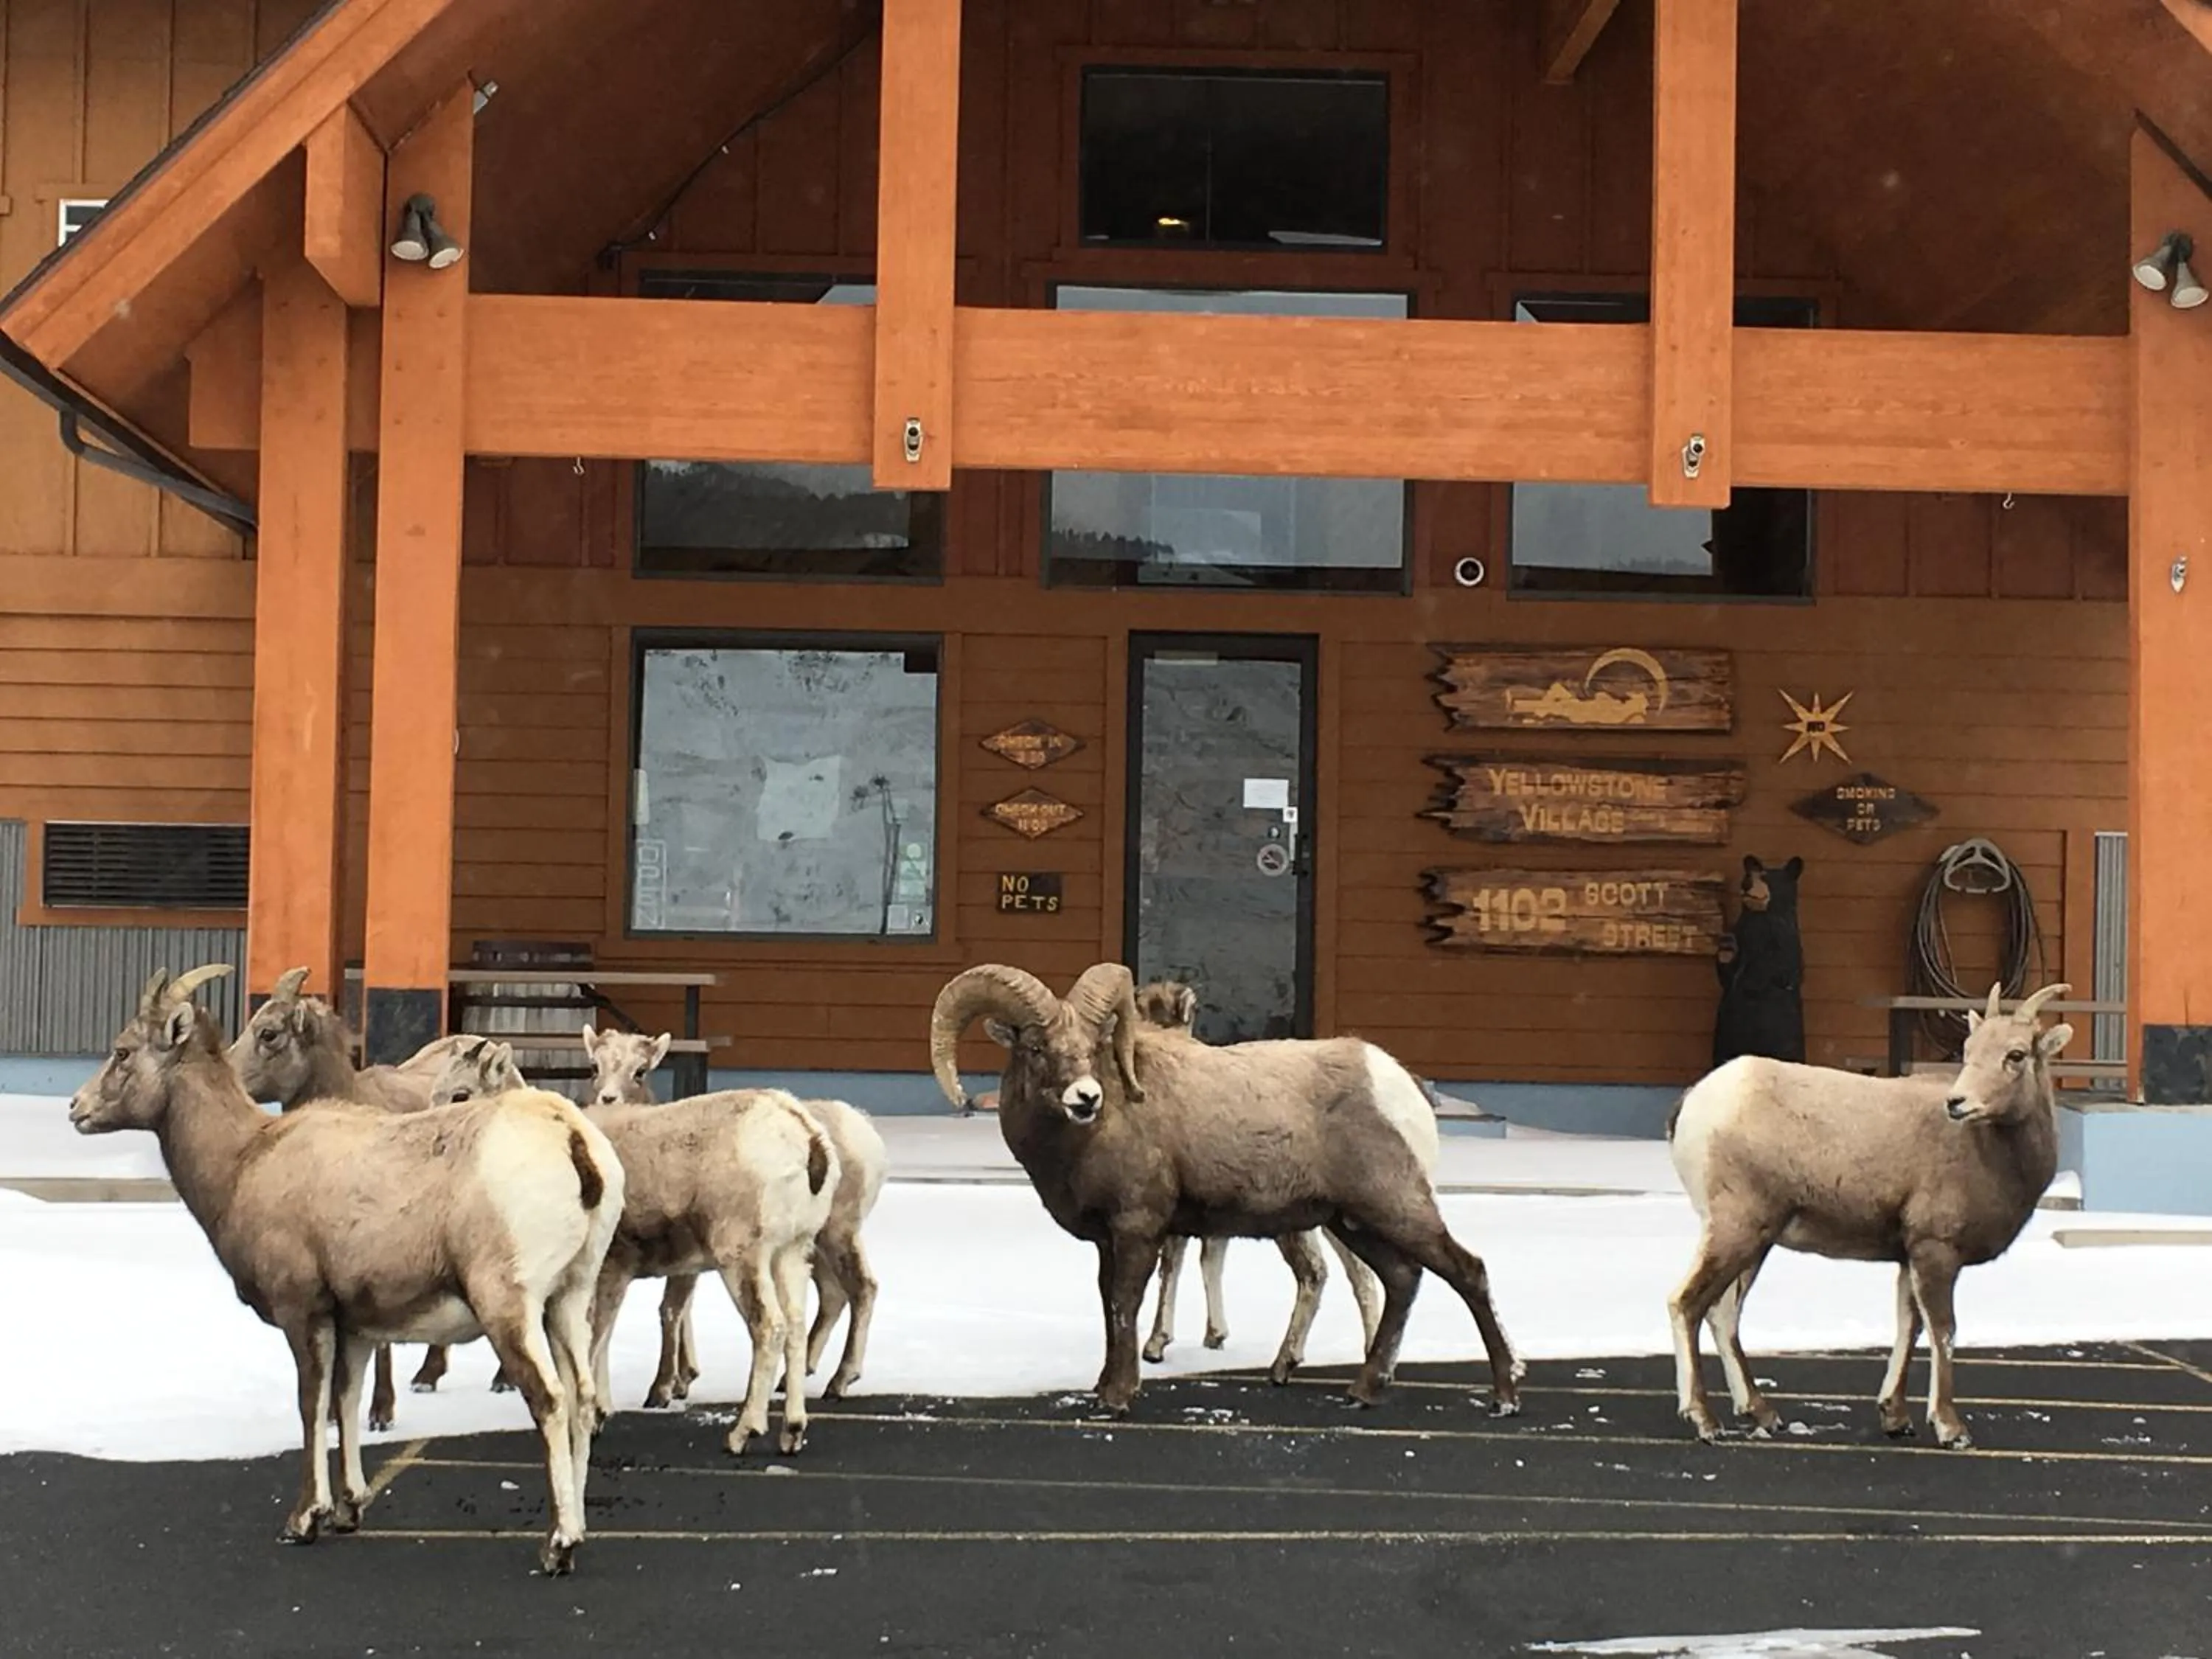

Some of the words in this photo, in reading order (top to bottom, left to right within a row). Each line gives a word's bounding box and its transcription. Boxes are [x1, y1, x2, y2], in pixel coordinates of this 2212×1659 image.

[1487, 768, 1667, 800] YELLOWSTONE
[1836, 787, 1896, 799] SMOKING
[1519, 803, 1624, 833] VILLAGE
[1857, 802, 1875, 815] OR
[1846, 818, 1882, 832] PETS
[1002, 874, 1029, 893] NO
[1001, 894, 1059, 911] PETS
[1473, 888, 1566, 931] 1102
[1585, 882, 1669, 907] SCOTT
[1603, 924, 1697, 948] STREET
